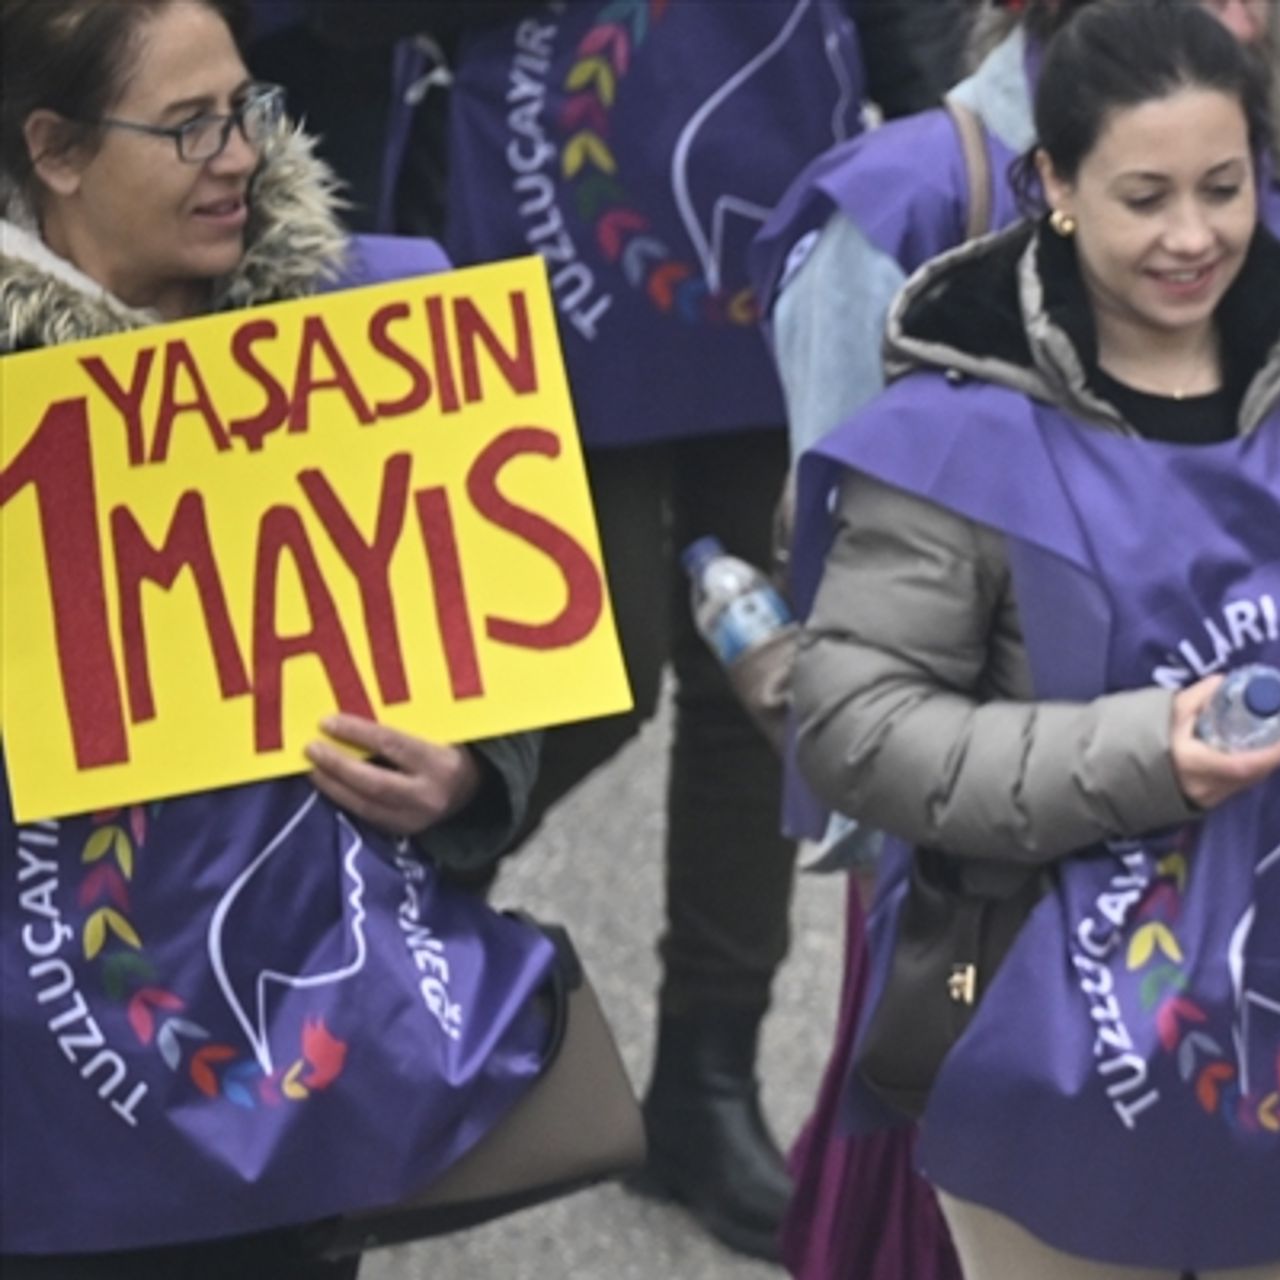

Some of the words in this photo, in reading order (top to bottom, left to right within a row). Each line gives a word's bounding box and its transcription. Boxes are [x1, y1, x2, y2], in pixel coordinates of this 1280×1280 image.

[78, 290, 540, 467] YAŞASIN
[0, 396, 129, 771] 1
[110, 427, 604, 754] MAYIS
